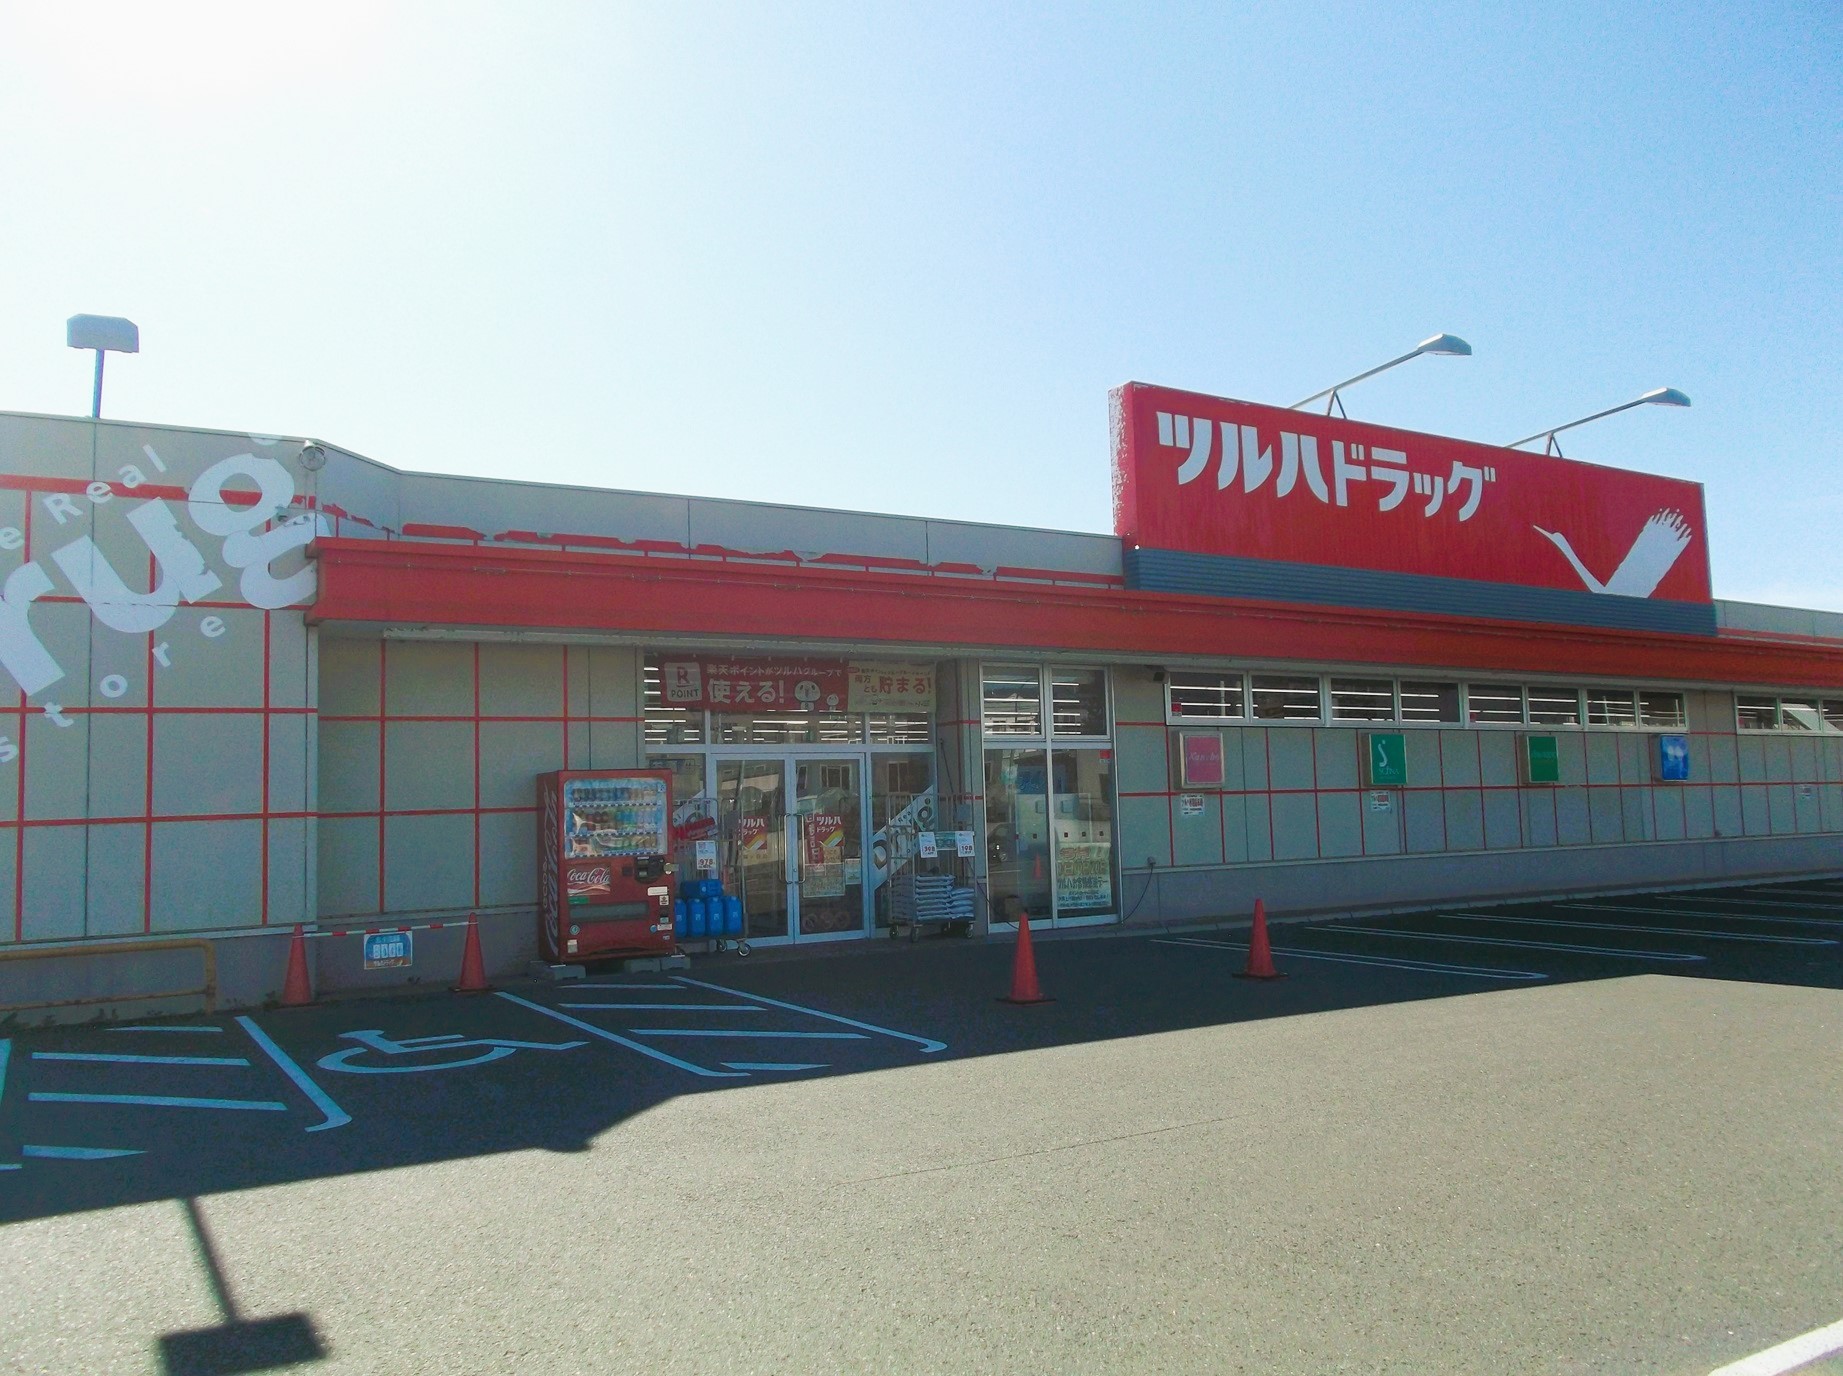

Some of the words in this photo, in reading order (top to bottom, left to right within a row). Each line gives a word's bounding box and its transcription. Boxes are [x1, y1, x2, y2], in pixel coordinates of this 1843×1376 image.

[41, 444, 167, 525] Real
[1156, 411, 1496, 522] ツルハドラッグ
[671, 688, 699, 699] POINT
[816, 816, 842, 826] ツルハ
